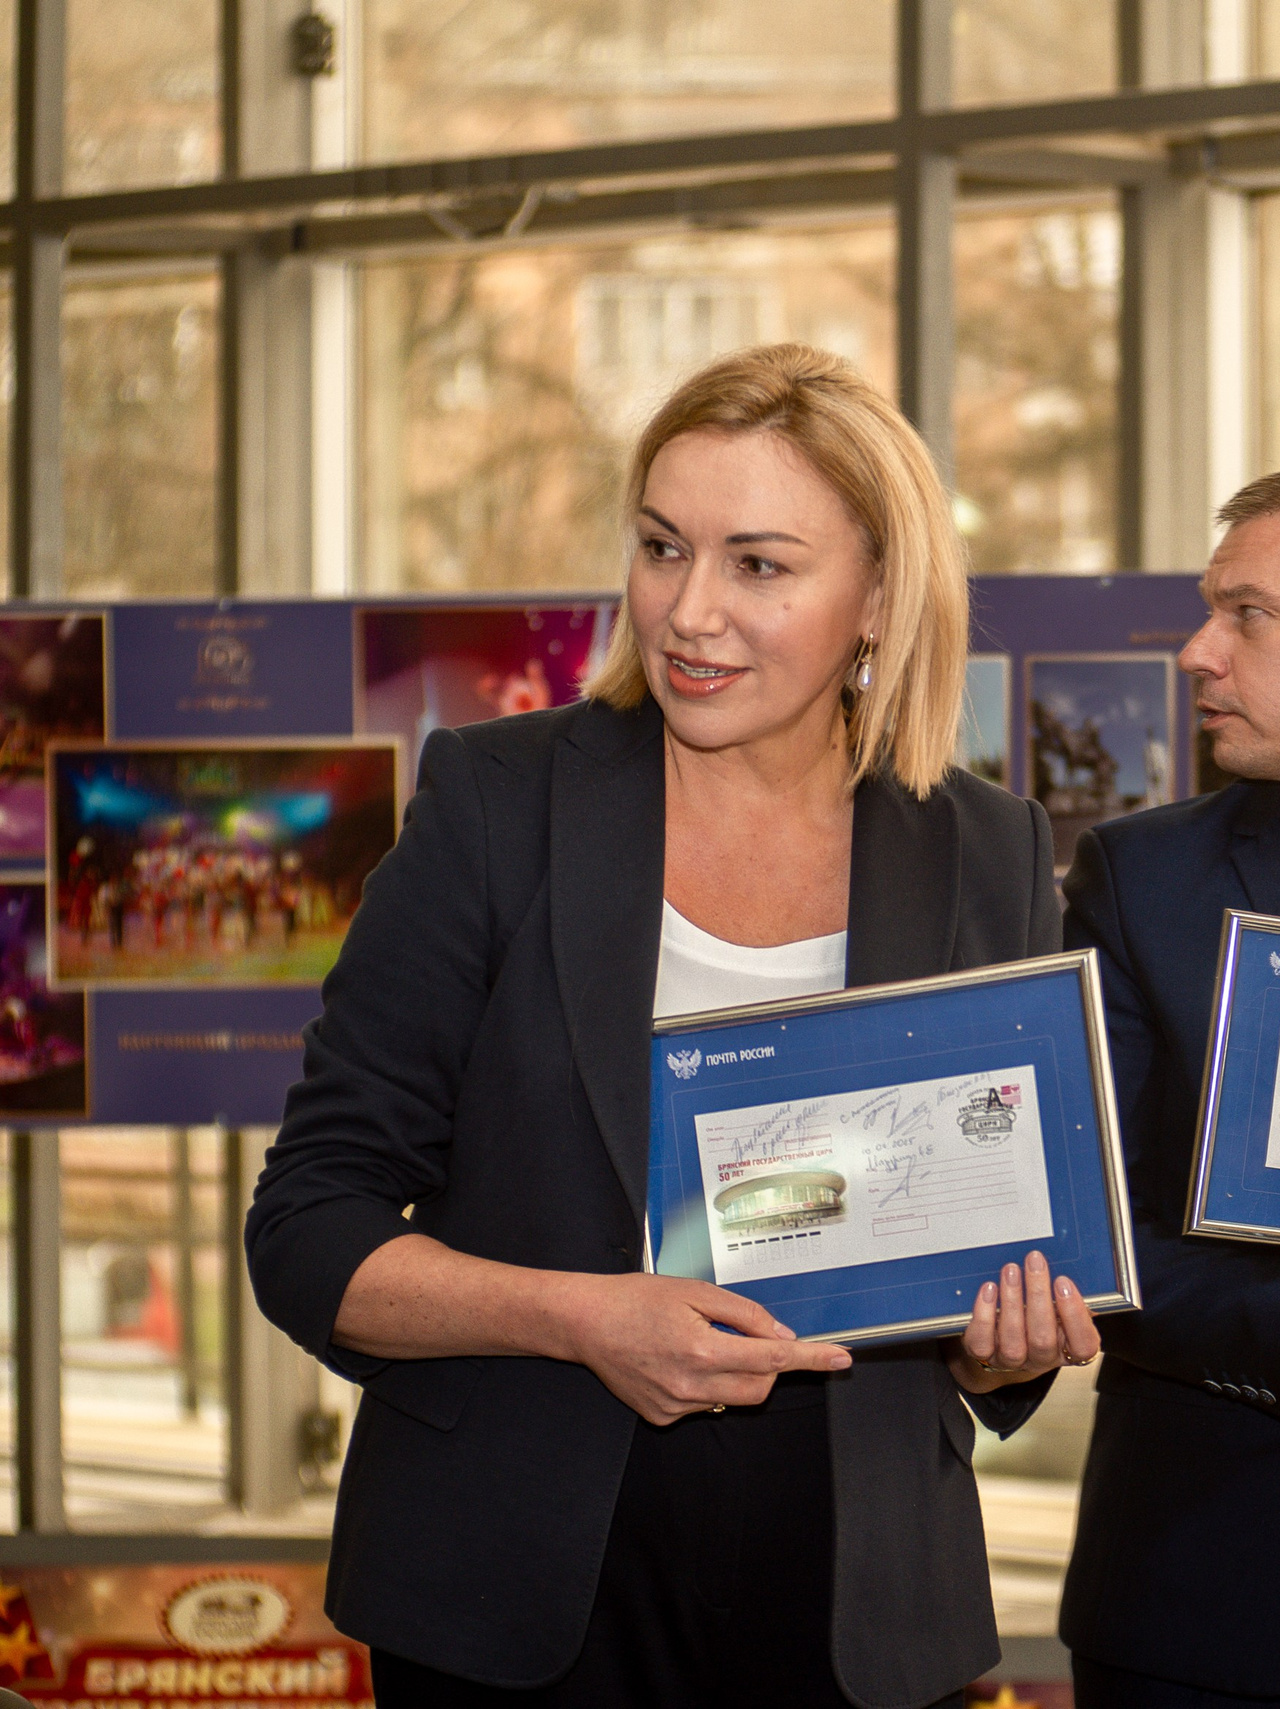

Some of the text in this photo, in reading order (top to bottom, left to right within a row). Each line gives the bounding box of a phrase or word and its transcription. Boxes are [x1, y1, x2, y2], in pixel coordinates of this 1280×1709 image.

[706, 1046, 775, 1067] ПОЧТА РОССИИ
[718, 1160, 751, 1172] БРЯНСКИЙ
[752, 1151, 814, 1165] ГОСУДАРСТВЕННЫЙ
[719, 1170, 744, 1182] 50 ЛЕТ
[85, 1650, 349, 1697] БРЯНСКИЙ
